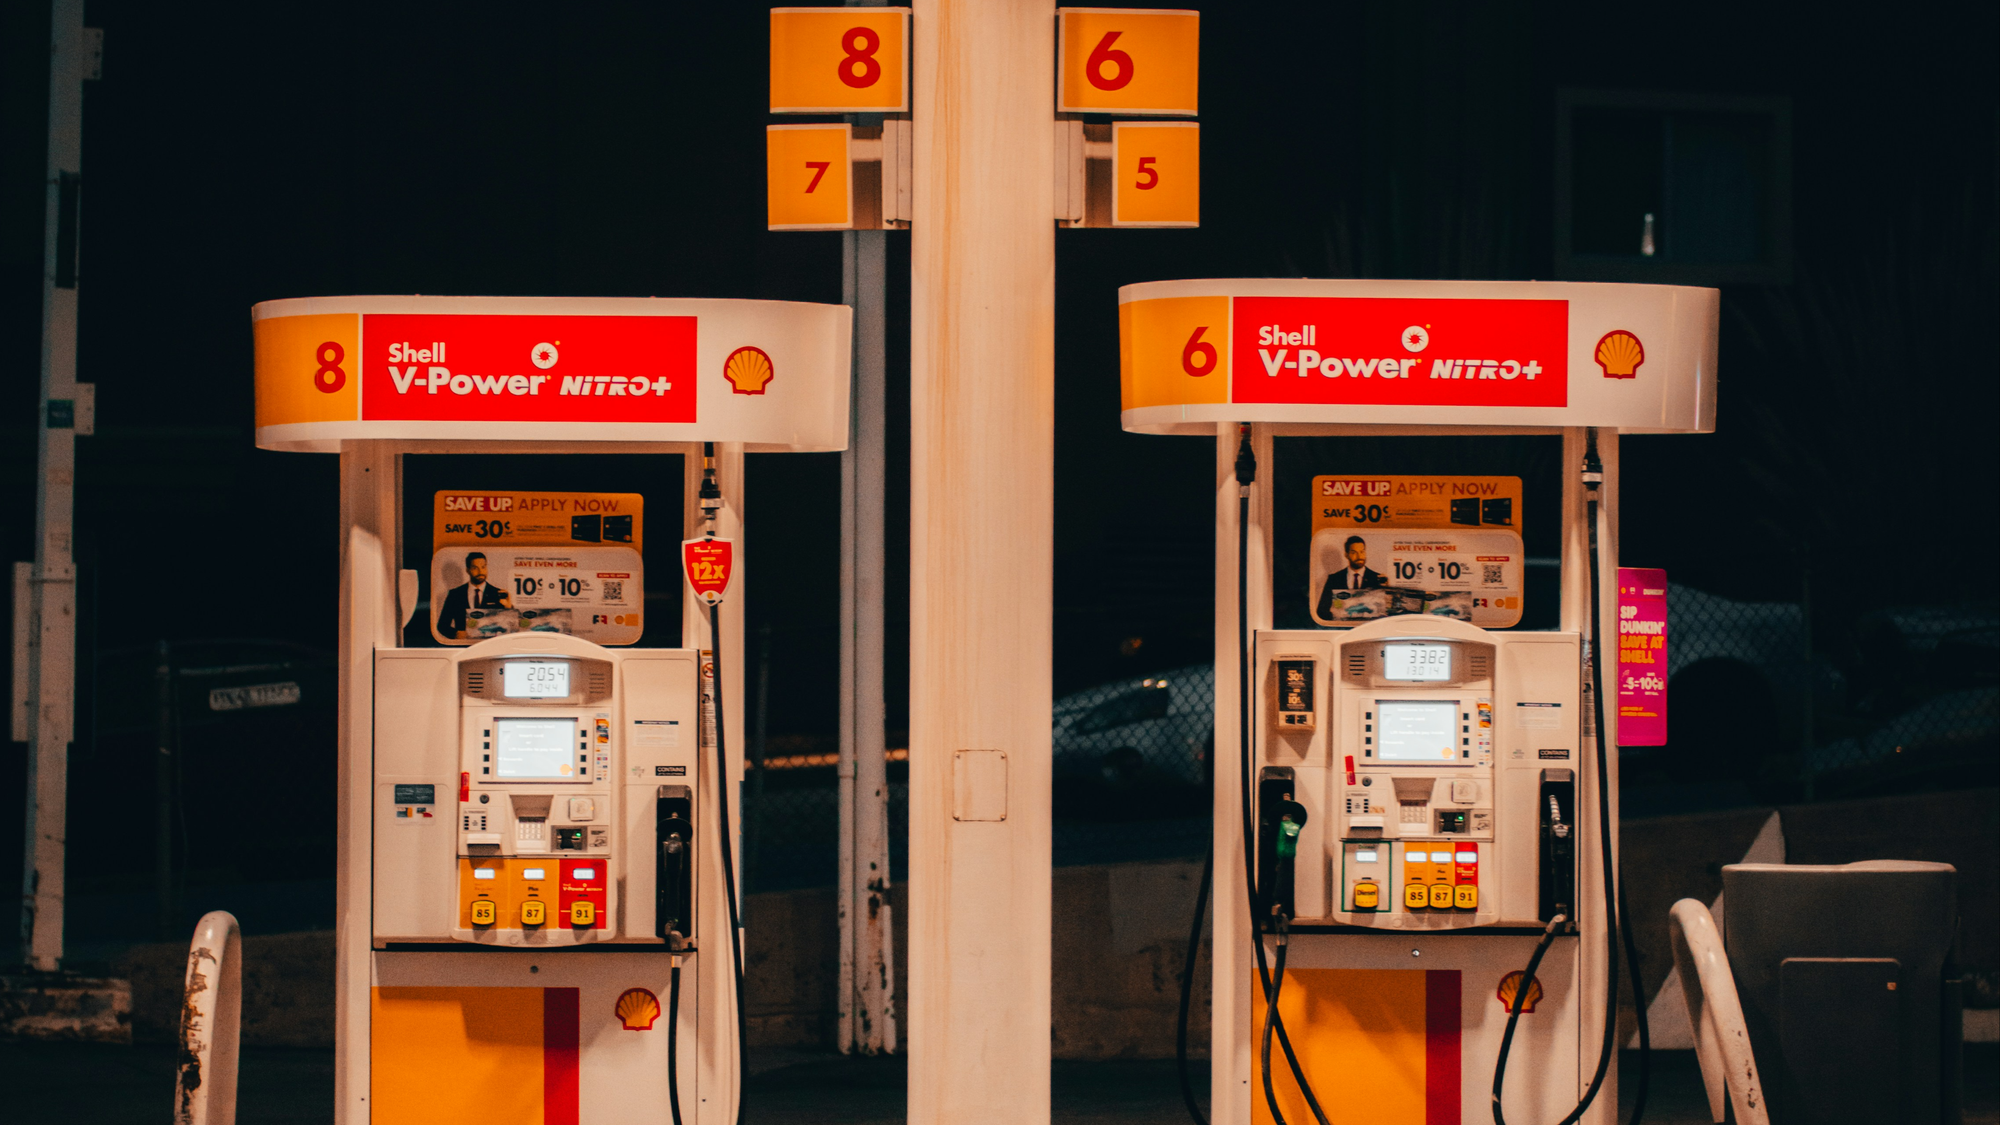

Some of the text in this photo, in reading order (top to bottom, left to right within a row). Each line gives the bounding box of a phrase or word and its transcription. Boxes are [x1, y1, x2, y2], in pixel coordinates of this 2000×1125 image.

[838, 27, 881, 88] 8
[1086, 31, 1134, 91] 6
[804, 162, 831, 193] 7
[1135, 157, 1159, 190] 5
[1258, 325, 1316, 346] Shell
[388, 342, 446, 363] Shell
[1182, 326, 1218, 377] 6
[315, 341, 346, 393] 8
[1258, 349, 1417, 379] V-Power
[388, 366, 547, 395] V-Power
[1323, 481, 1361, 495] SAVE
[1396, 483, 1446, 495] APPLY
[445, 496, 484, 511] SAVE
[518, 499, 566, 511] APPLY
[1323, 508, 1351, 518] SAVE
[445, 523, 472, 533] SAVE
[1620, 605, 1637, 619] SIP
[1650, 636, 1664, 649] AT
[1410, 892, 1424, 900] 85
[1435, 892, 1448, 901] 87
[1459, 892, 1472, 901] 91
[476, 909, 490, 918] 85
[526, 909, 539, 918] 87
[576, 910, 589, 918] 91
